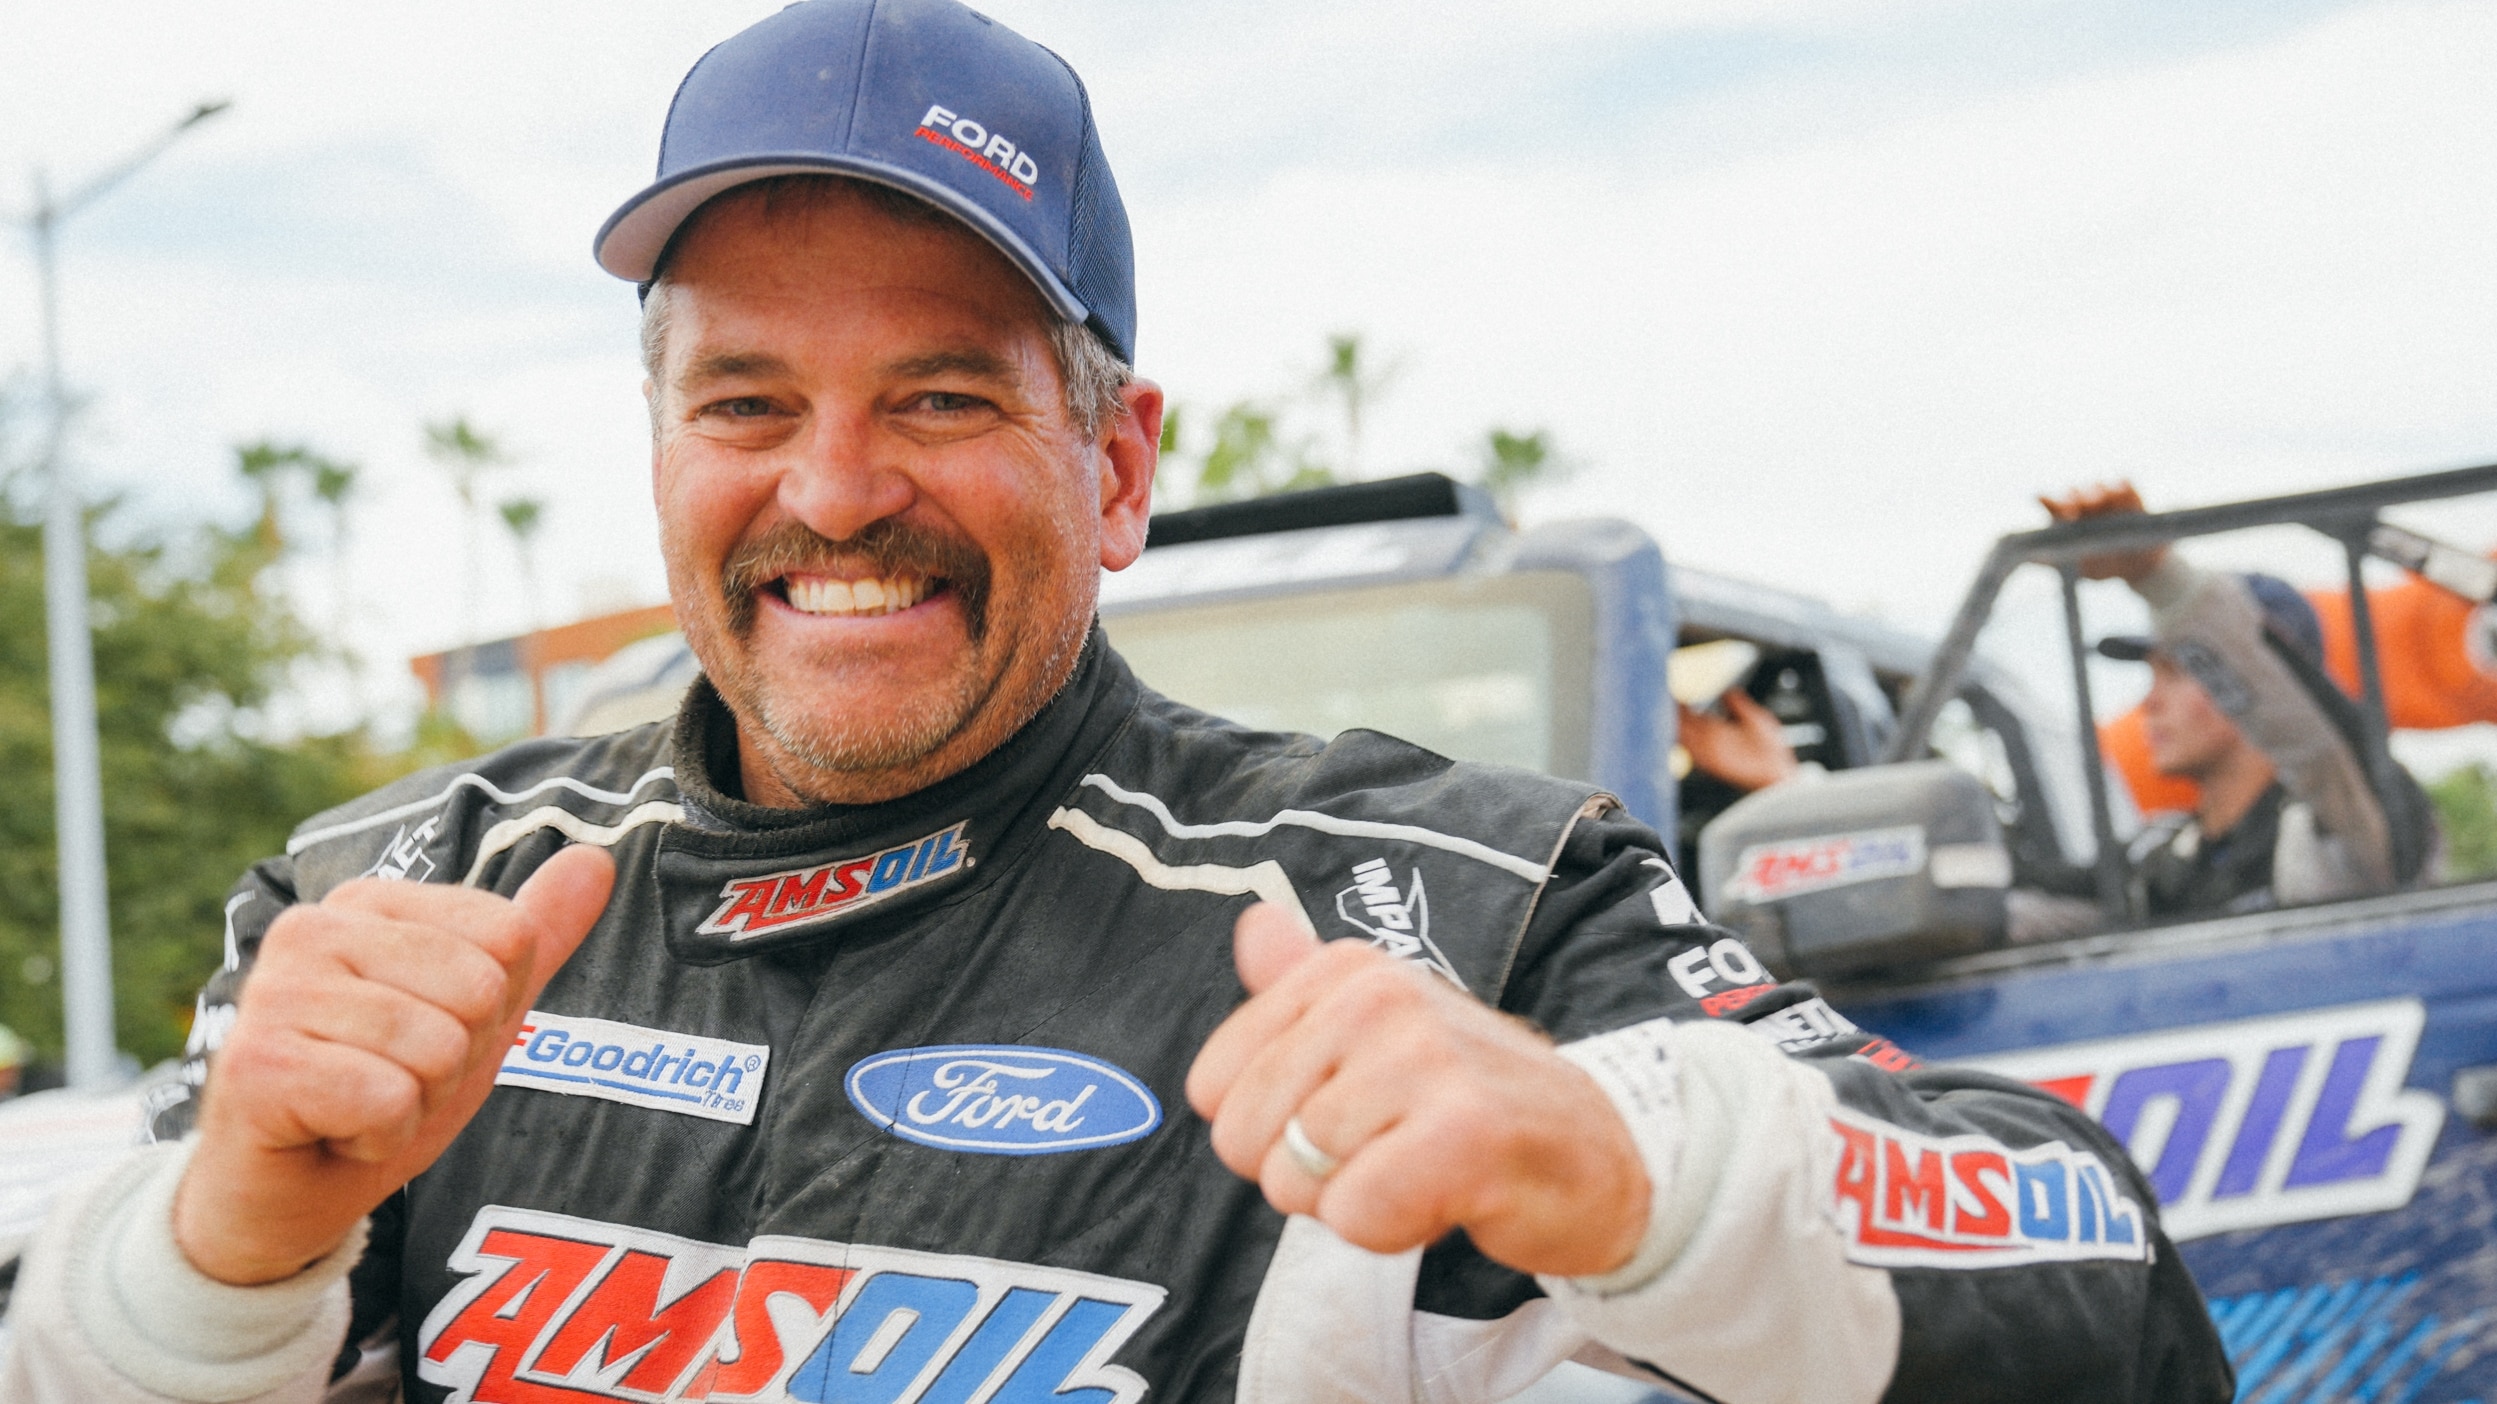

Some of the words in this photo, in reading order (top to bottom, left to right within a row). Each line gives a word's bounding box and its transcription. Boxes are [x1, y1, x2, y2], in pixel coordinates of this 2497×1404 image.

[914, 125, 1034, 202] PERFORMANCE
[920, 104, 1039, 186] FORD
[708, 825, 964, 934] AMSOIL
[1351, 857, 1432, 969] IMPA
[1666, 937, 1777, 999] FO
[905, 1059, 1099, 1133] Ford
[2028, 1033, 2404, 1208] OIL
[1827, 1114, 2137, 1253] AMSOIL
[422, 1226, 1145, 1404] AMSOIL
